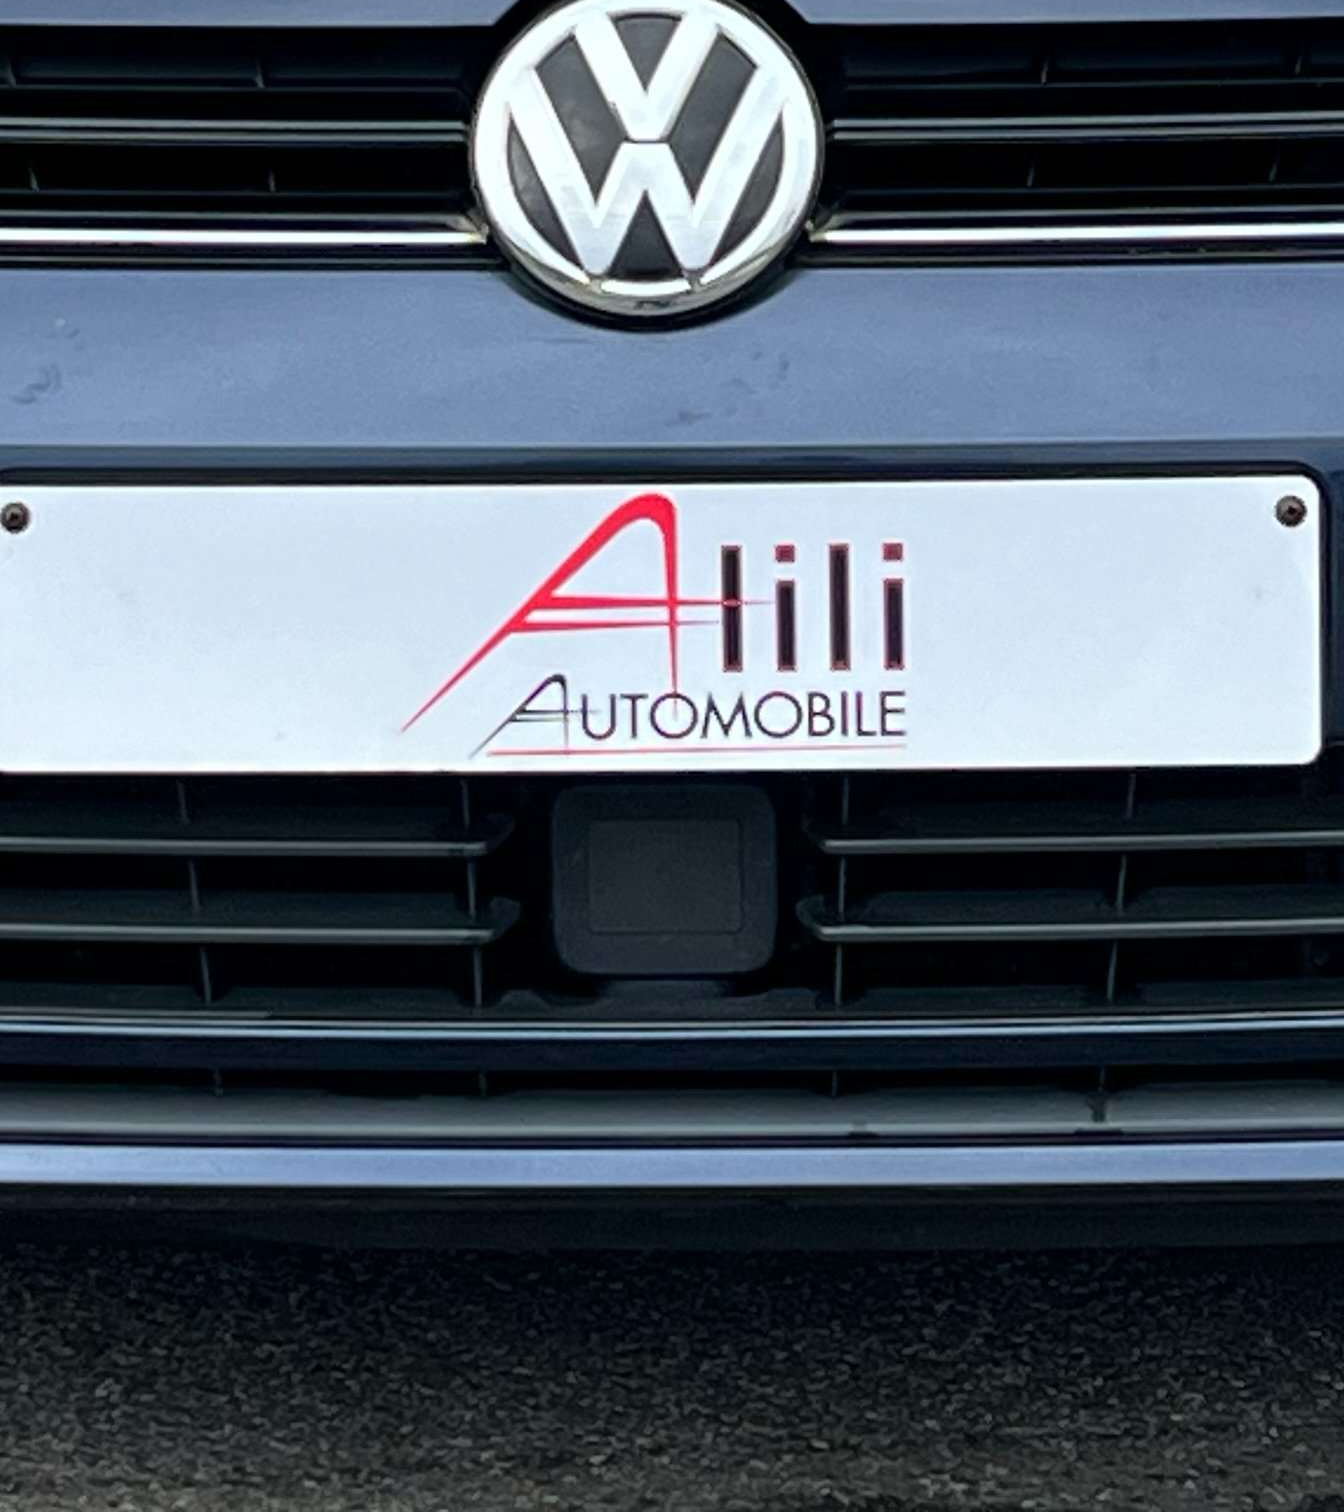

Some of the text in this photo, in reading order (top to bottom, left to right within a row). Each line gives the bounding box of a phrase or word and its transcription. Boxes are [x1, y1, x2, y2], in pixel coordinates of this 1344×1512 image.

[499, 0, 793, 280] VW
[400, 492, 907, 732] Alili
[468, 673, 907, 759] AUTOMOBILE
